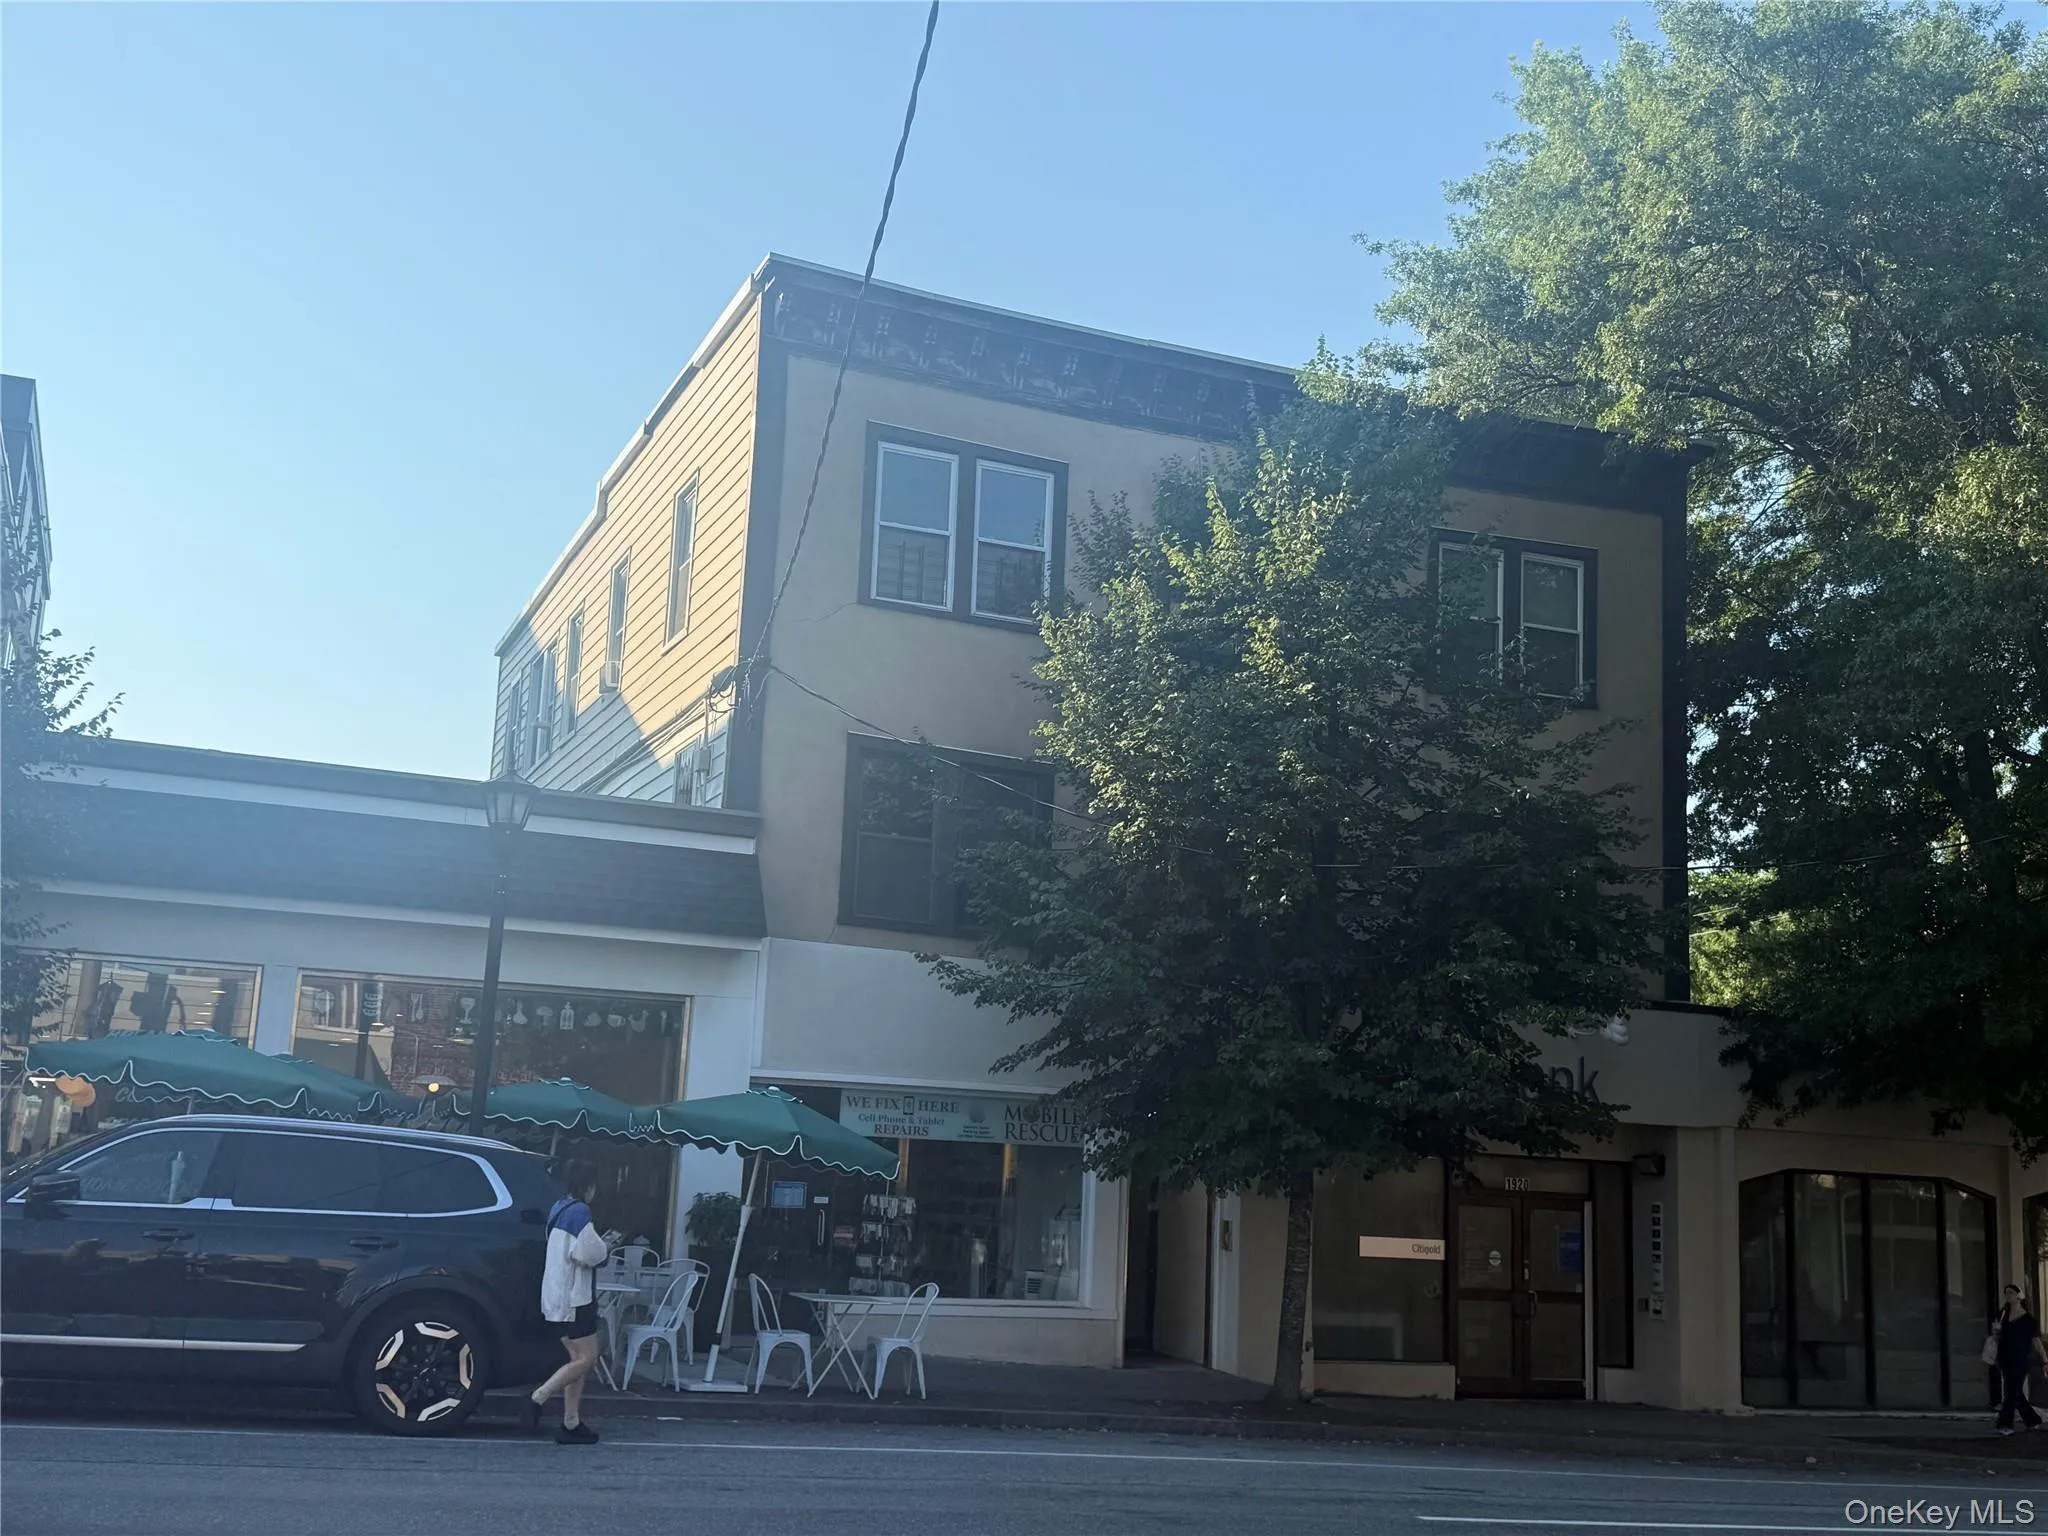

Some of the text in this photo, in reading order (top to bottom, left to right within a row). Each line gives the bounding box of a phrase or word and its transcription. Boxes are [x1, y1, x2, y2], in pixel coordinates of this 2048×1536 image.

[846, 1095, 959, 1114] WE FIX HERE
[858, 1113, 945, 1127] Cell Phone & Tablet
[1004, 1103, 1081, 1126] MOBILE
[874, 1123, 929, 1137] REPAIRS
[1005, 1122, 1082, 1144] RESCUE
[1504, 1177, 1530, 1191] 1920
[1411, 1243, 1441, 1256] Citigold
